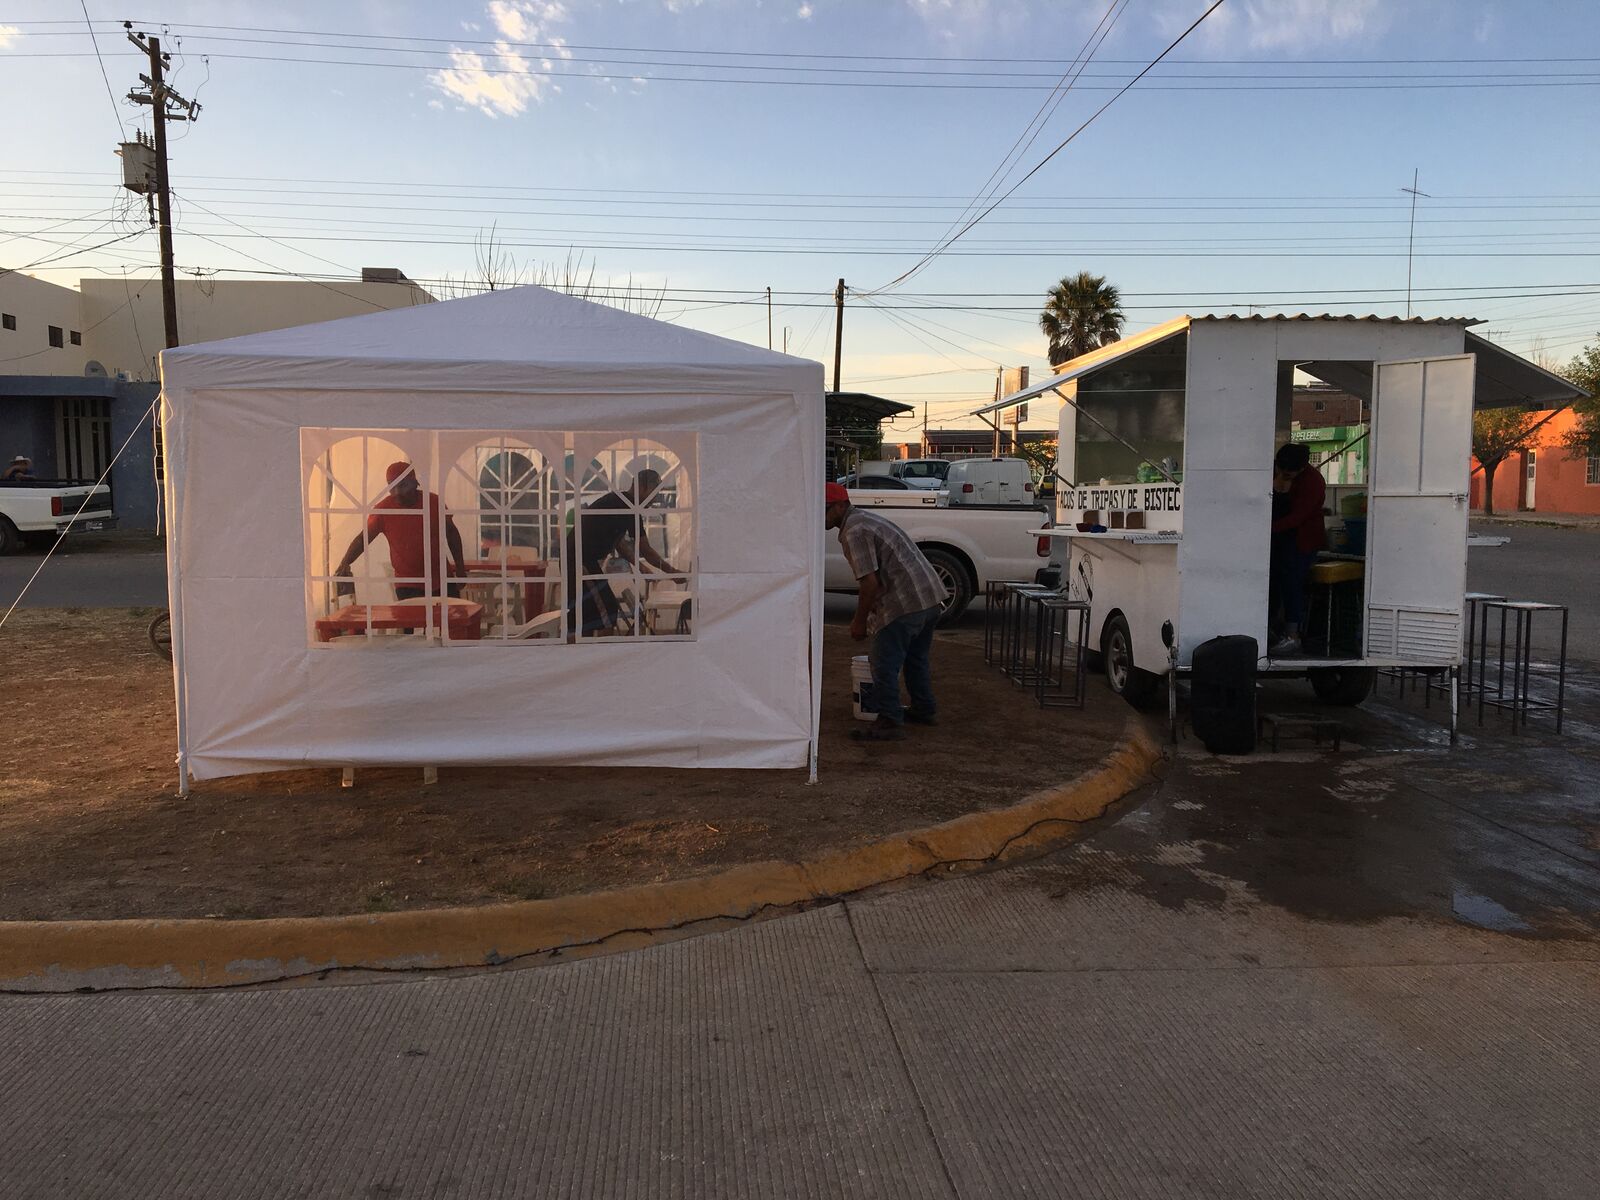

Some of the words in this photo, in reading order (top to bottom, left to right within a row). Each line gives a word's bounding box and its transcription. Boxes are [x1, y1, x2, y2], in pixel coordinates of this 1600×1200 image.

[1056, 490, 1075, 509] TACOS
[1078, 490, 1087, 509] DE
[1091, 490, 1118, 510] TRIPAS
[1120, 490, 1126, 509] Y
[1127, 489, 1138, 509] DE
[1144, 487, 1181, 511] BISTEC
